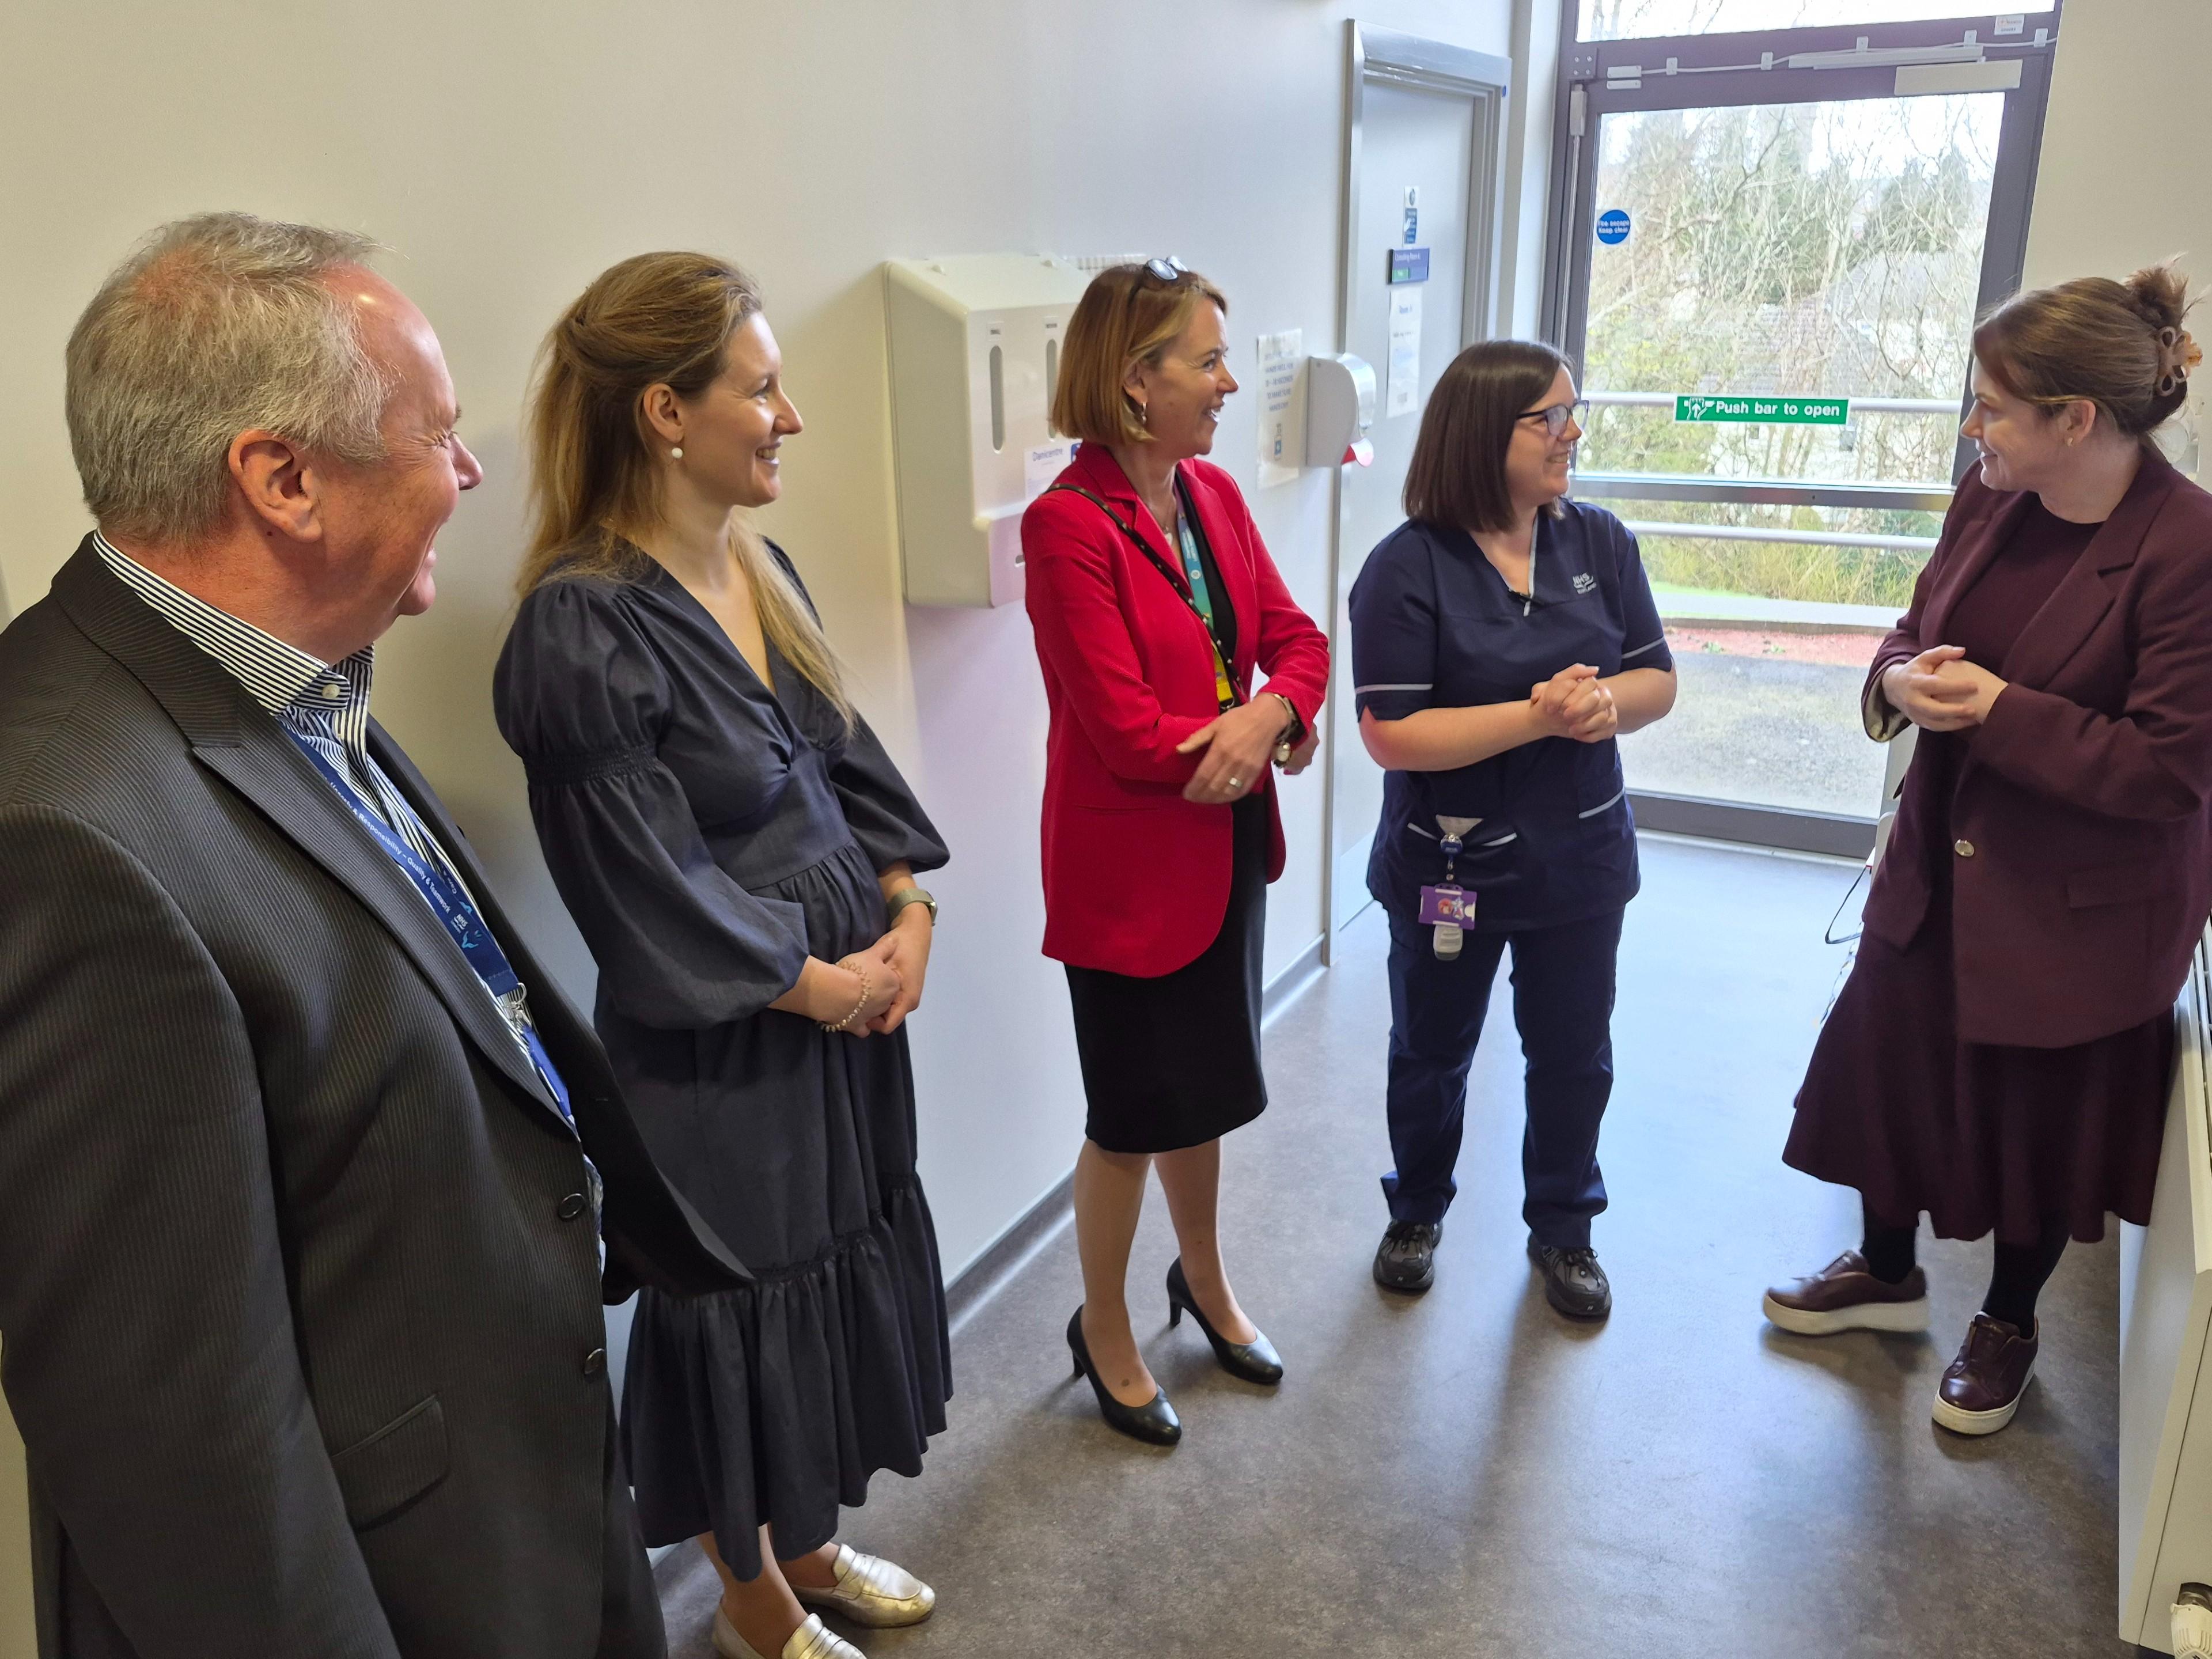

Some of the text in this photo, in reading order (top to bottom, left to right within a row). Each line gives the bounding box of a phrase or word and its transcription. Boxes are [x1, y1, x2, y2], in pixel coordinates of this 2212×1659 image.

[1715, 400, 1840, 418] Push bar to open
[1573, 573, 1590, 585] NHS
[358, 813, 403, 855] Responsibility
[407, 857, 427, 880] Quality
[425, 876, 431, 885] &
[429, 881, 452, 914] Teamwork
[456, 913, 468, 928] NHS
